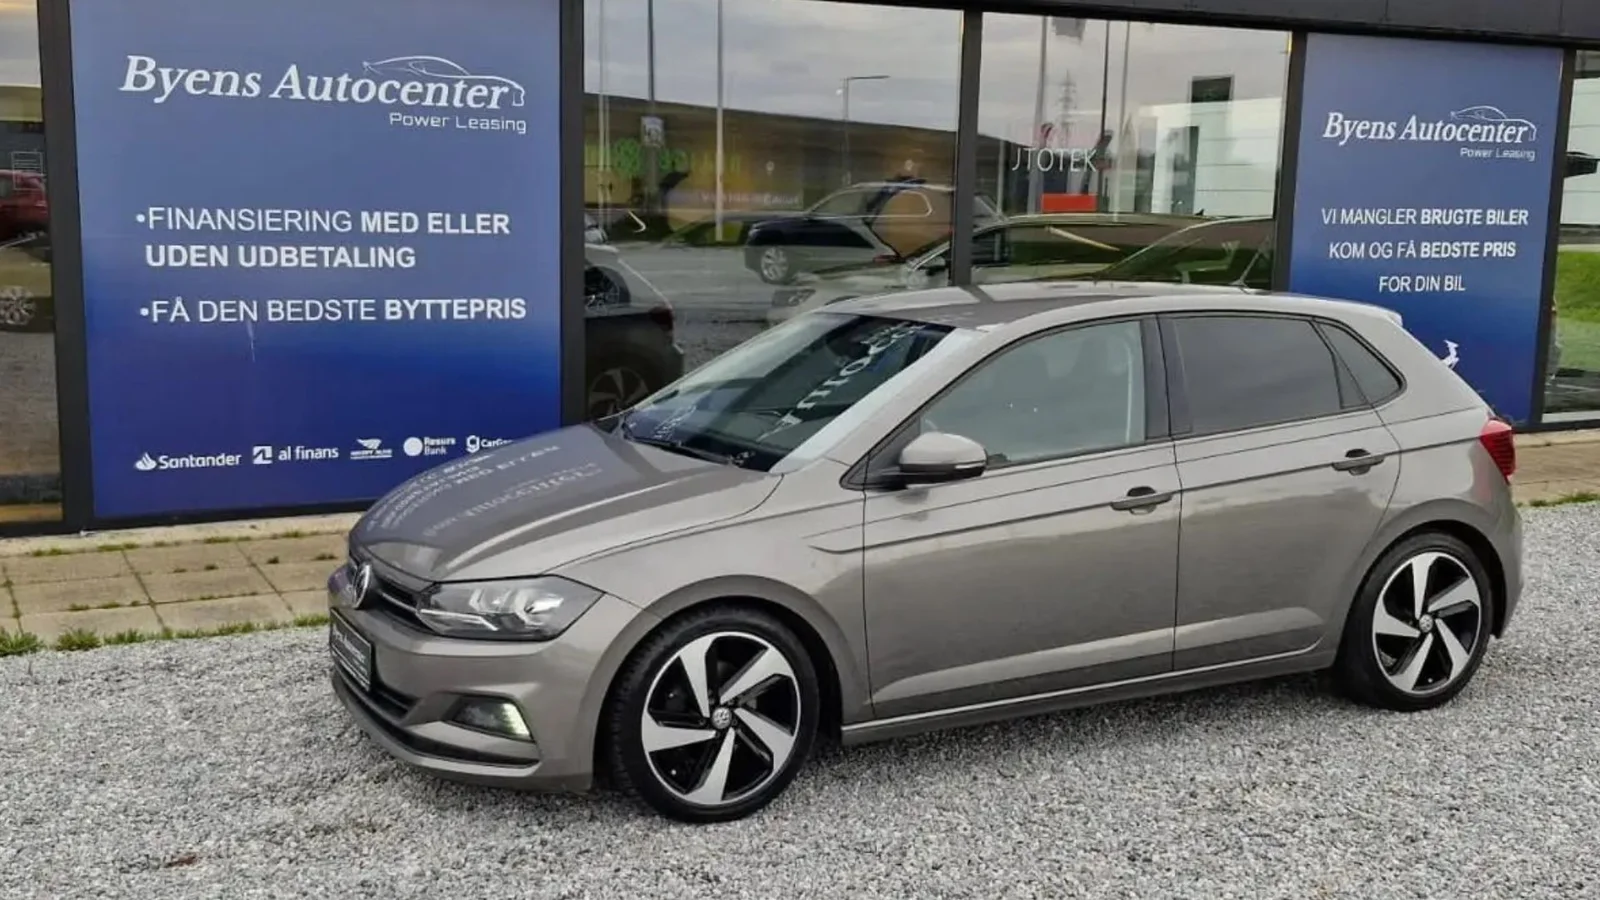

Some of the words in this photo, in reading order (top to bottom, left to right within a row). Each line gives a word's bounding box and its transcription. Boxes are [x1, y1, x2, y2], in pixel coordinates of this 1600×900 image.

[120, 55, 262, 104] Byens
[269, 64, 509, 109] Autocenter
[389, 112, 450, 127] Power
[455, 116, 527, 135] Leasing
[1322, 111, 1397, 146] Byens
[1399, 114, 1528, 144] Autocenter
[1460, 147, 1493, 158] Power
[1495, 148, 1535, 162] Leasing
[148, 206, 353, 233] FINANSIERING
[360, 210, 420, 233] MED
[427, 212, 510, 235] ELLER
[1321, 208, 1337, 225] VI
[1340, 208, 1417, 225] MANGLER
[1420, 208, 1483, 226] BRUGTE
[1486, 208, 1529, 226] BILER
[145, 244, 229, 267] UDEN
[238, 245, 416, 268] UDBETALING
[1329, 241, 1365, 259] KOM
[1368, 241, 1393, 259] OG
[1396, 239, 1417, 258] FÅ
[1420, 241, 1480, 259] BEDSTE
[1483, 241, 1517, 258] PRIS
[1379, 275, 1412, 293] FOR
[1414, 275, 1441, 292] DIN
[1443, 274, 1467, 292] BIL
[152, 296, 191, 323] FÅ
[198, 300, 258, 322] DEN
[266, 299, 377, 322] BEDSTE
[384, 298, 527, 320] BYTTEPRIS
[278, 445, 292, 461] al
[294, 445, 340, 461] finans
[423, 445, 447, 456] Bank
[158, 452, 243, 471] Santander
